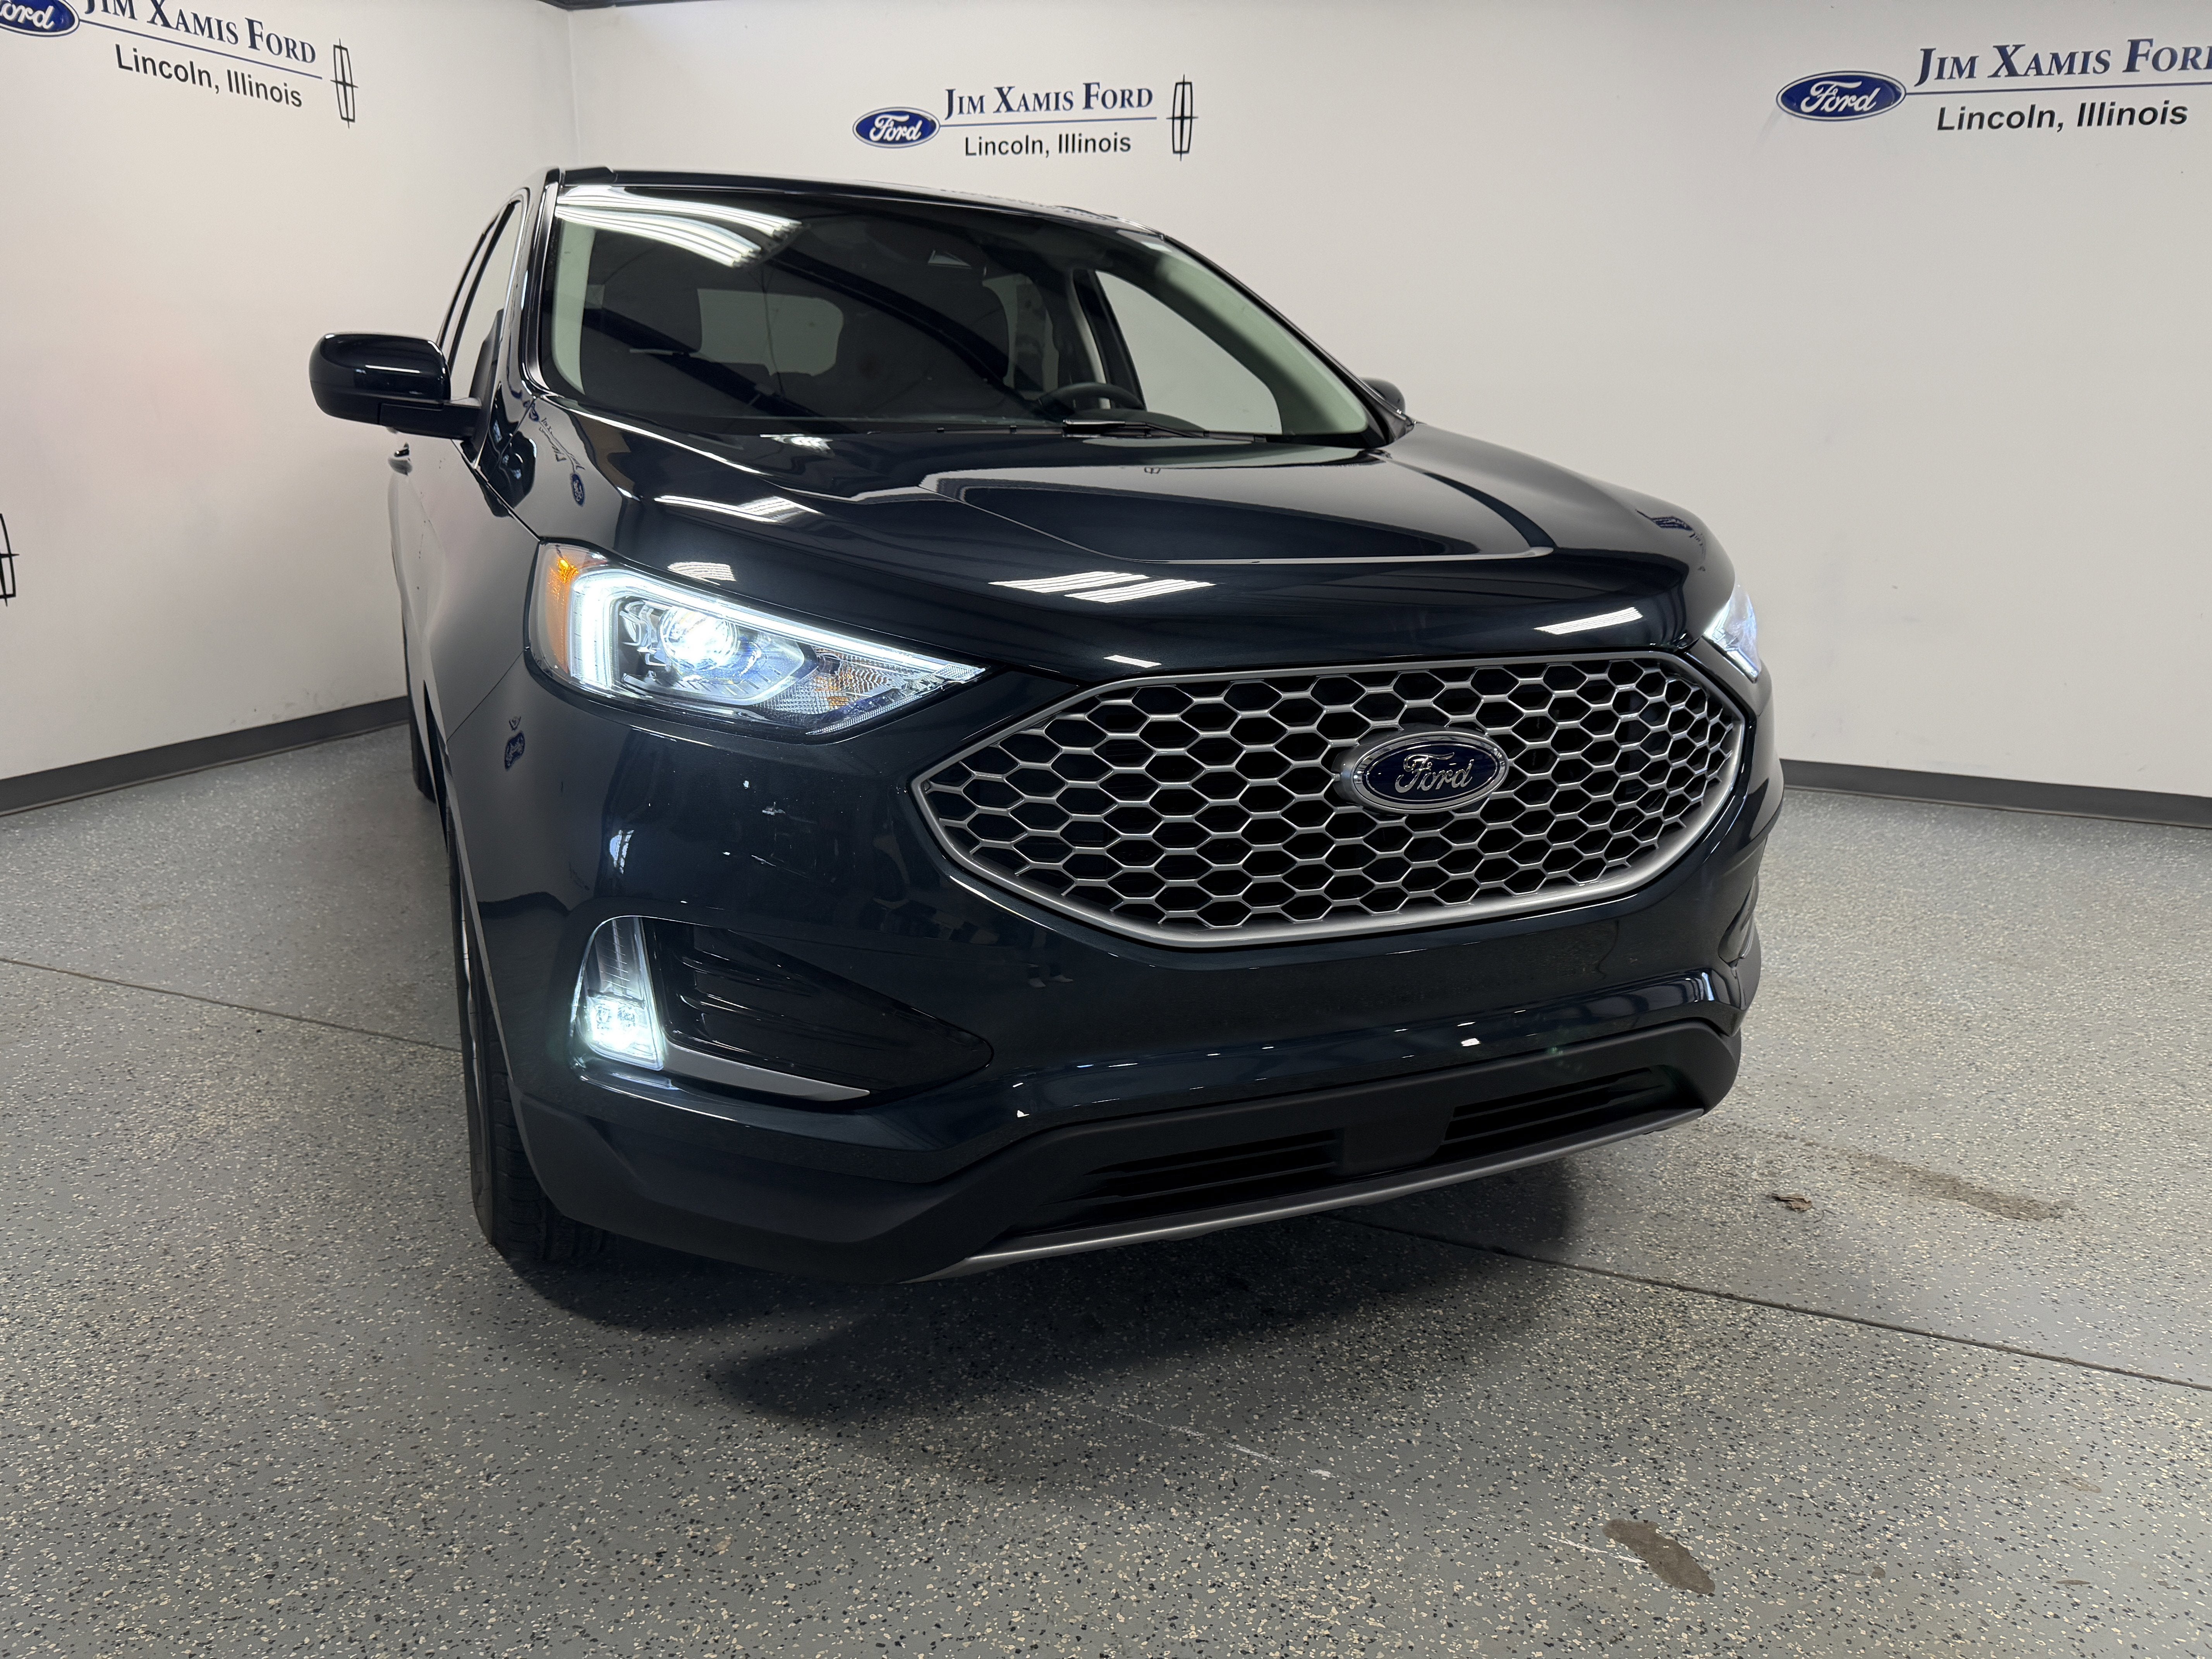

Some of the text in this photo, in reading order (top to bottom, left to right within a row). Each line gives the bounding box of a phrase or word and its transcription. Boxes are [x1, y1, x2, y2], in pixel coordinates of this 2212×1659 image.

[0, 0, 55, 29] ord
[146, 0, 239, 45] XAMIS
[245, 17, 316, 64] FORD
[115, 44, 302, 108] Lincoln, Illinois
[1913, 48, 1979, 87] JIM
[1987, 44, 2111, 78] XAMIS
[944, 82, 1153, 120] JIM XAMIS FORD
[1800, 81, 1877, 113] Ford
[869, 114, 922, 141] Ford
[1937, 100, 2188, 133] Lincoln, Illinois
[965, 132, 1131, 158] Lincoln, Illinois
[1395, 752, 1475, 793] Ford
